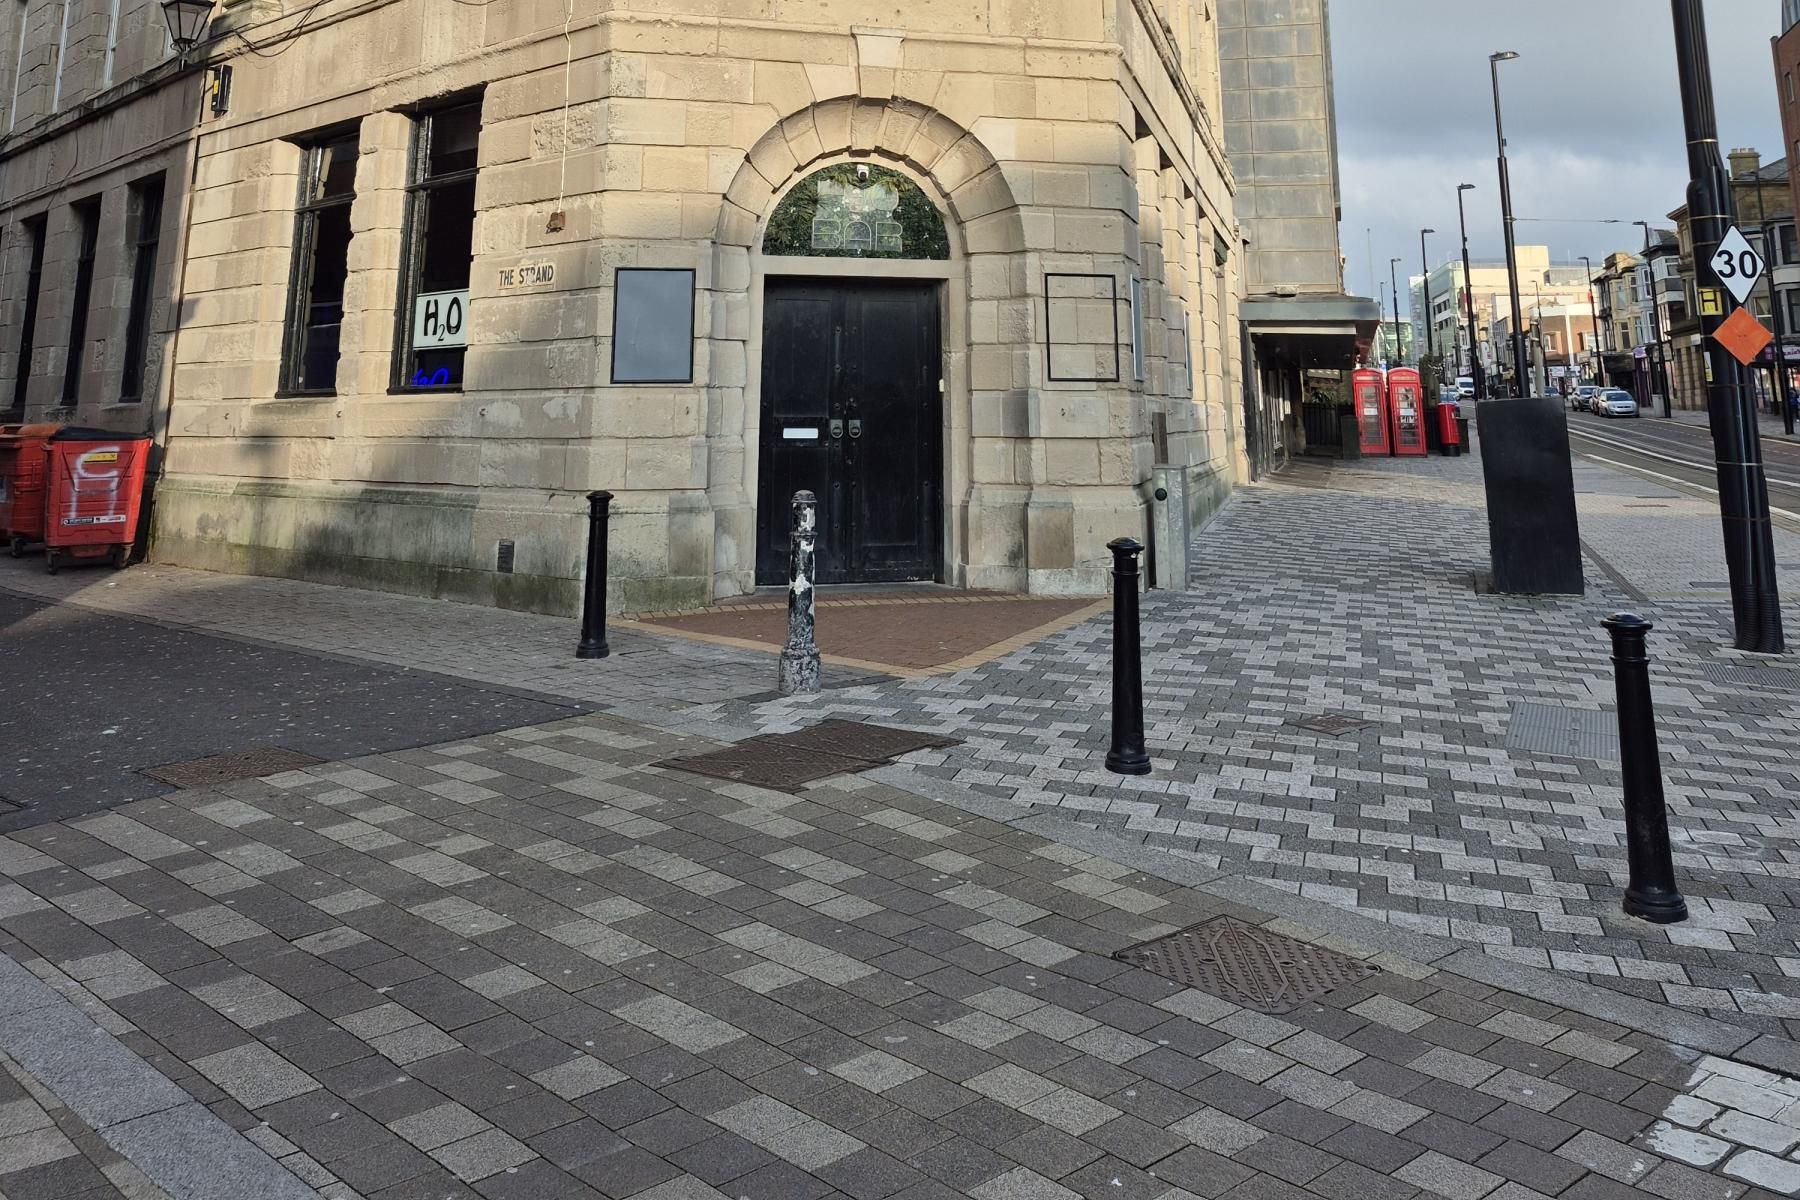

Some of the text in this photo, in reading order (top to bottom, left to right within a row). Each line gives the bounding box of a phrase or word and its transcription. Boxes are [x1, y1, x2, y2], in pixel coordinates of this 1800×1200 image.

[811, 218, 904, 253] BAR
[1716, 249, 1758, 279] 30
[499, 269, 514, 287] THE
[1700, 289, 1719, 313] H
